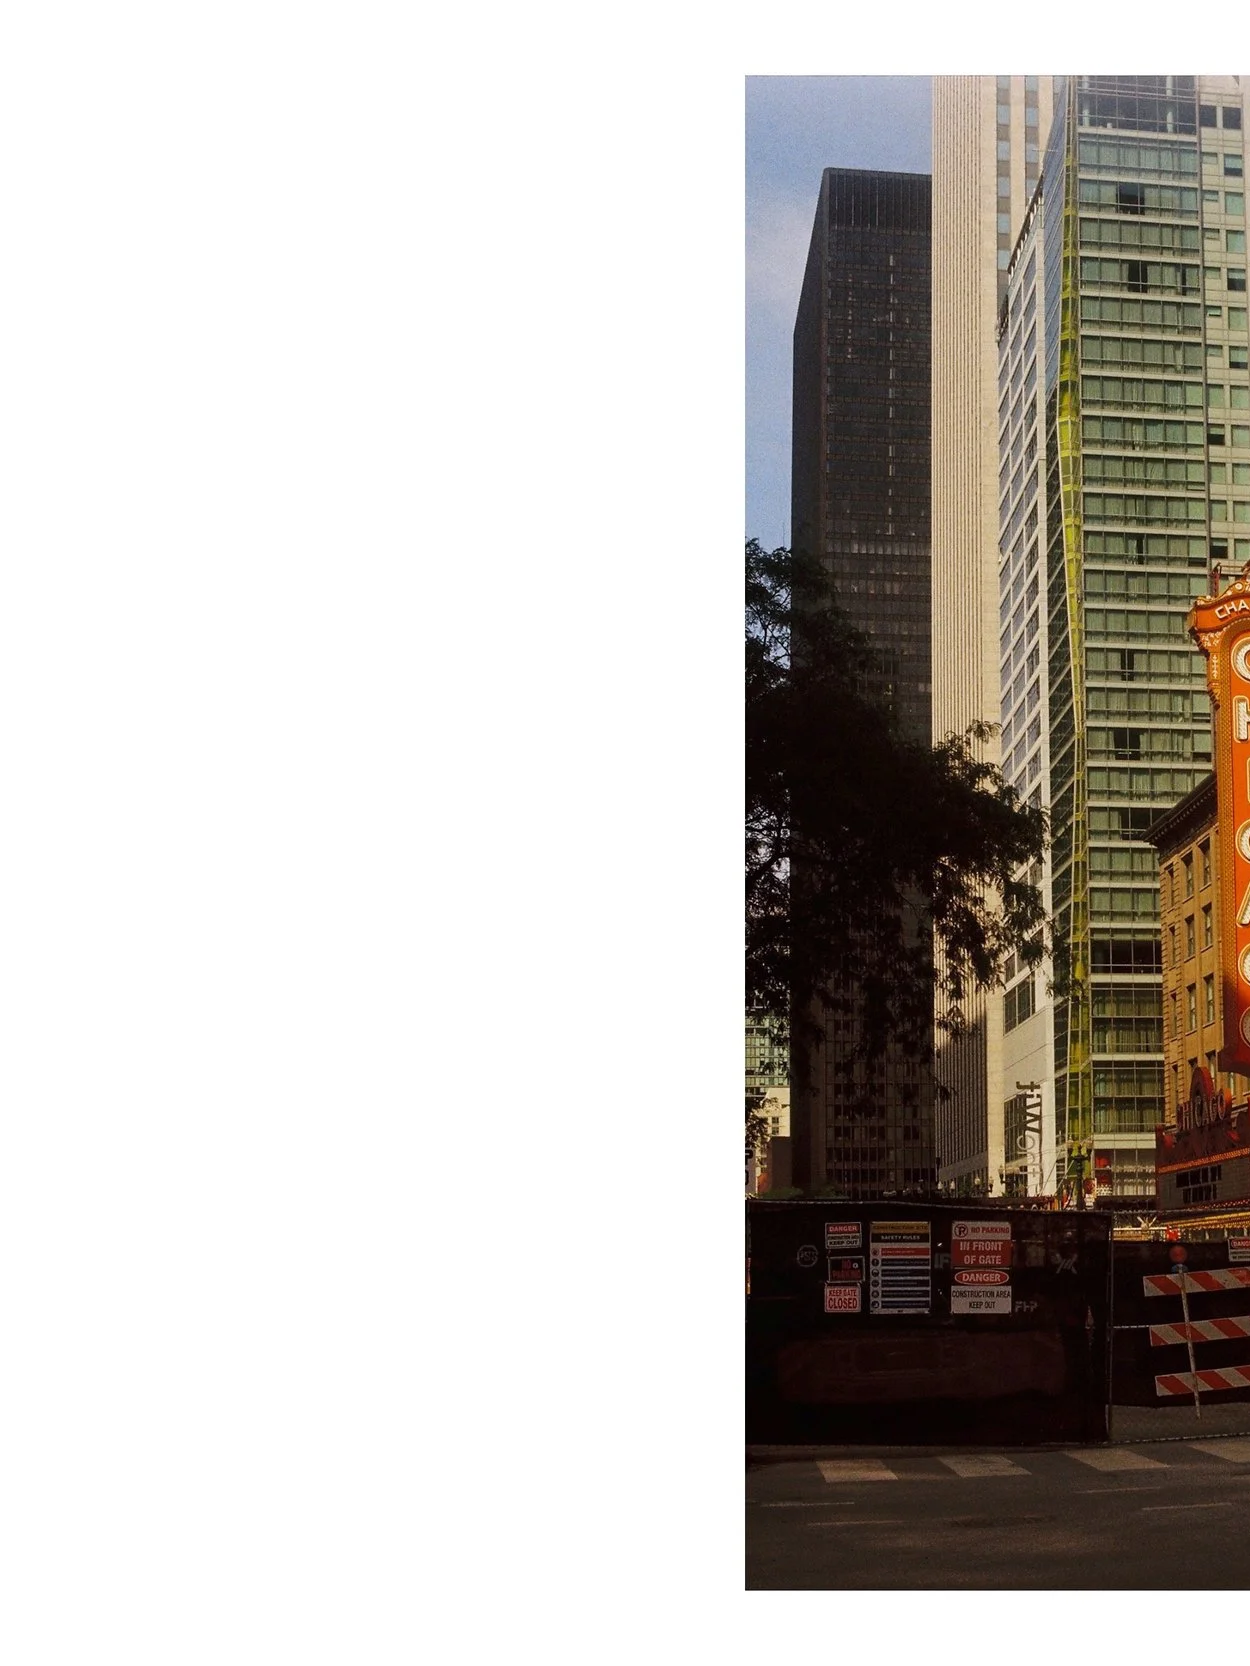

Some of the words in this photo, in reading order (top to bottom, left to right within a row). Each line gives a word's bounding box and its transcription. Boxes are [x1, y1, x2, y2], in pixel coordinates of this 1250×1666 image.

[972, 1241, 1003, 1251] FRONT
[964, 1255, 976, 1265] OF
[979, 1255, 1002, 1265] GATE
[962, 1273, 1001, 1282] DANGER
[952, 1290, 994, 1298] CONSTRUCTION
[996, 1290, 1010, 1298] AREA
[828, 1298, 857, 1309] CLOSED
[969, 1301, 983, 1309] KEEP
[985, 1301, 996, 1309] OUT
